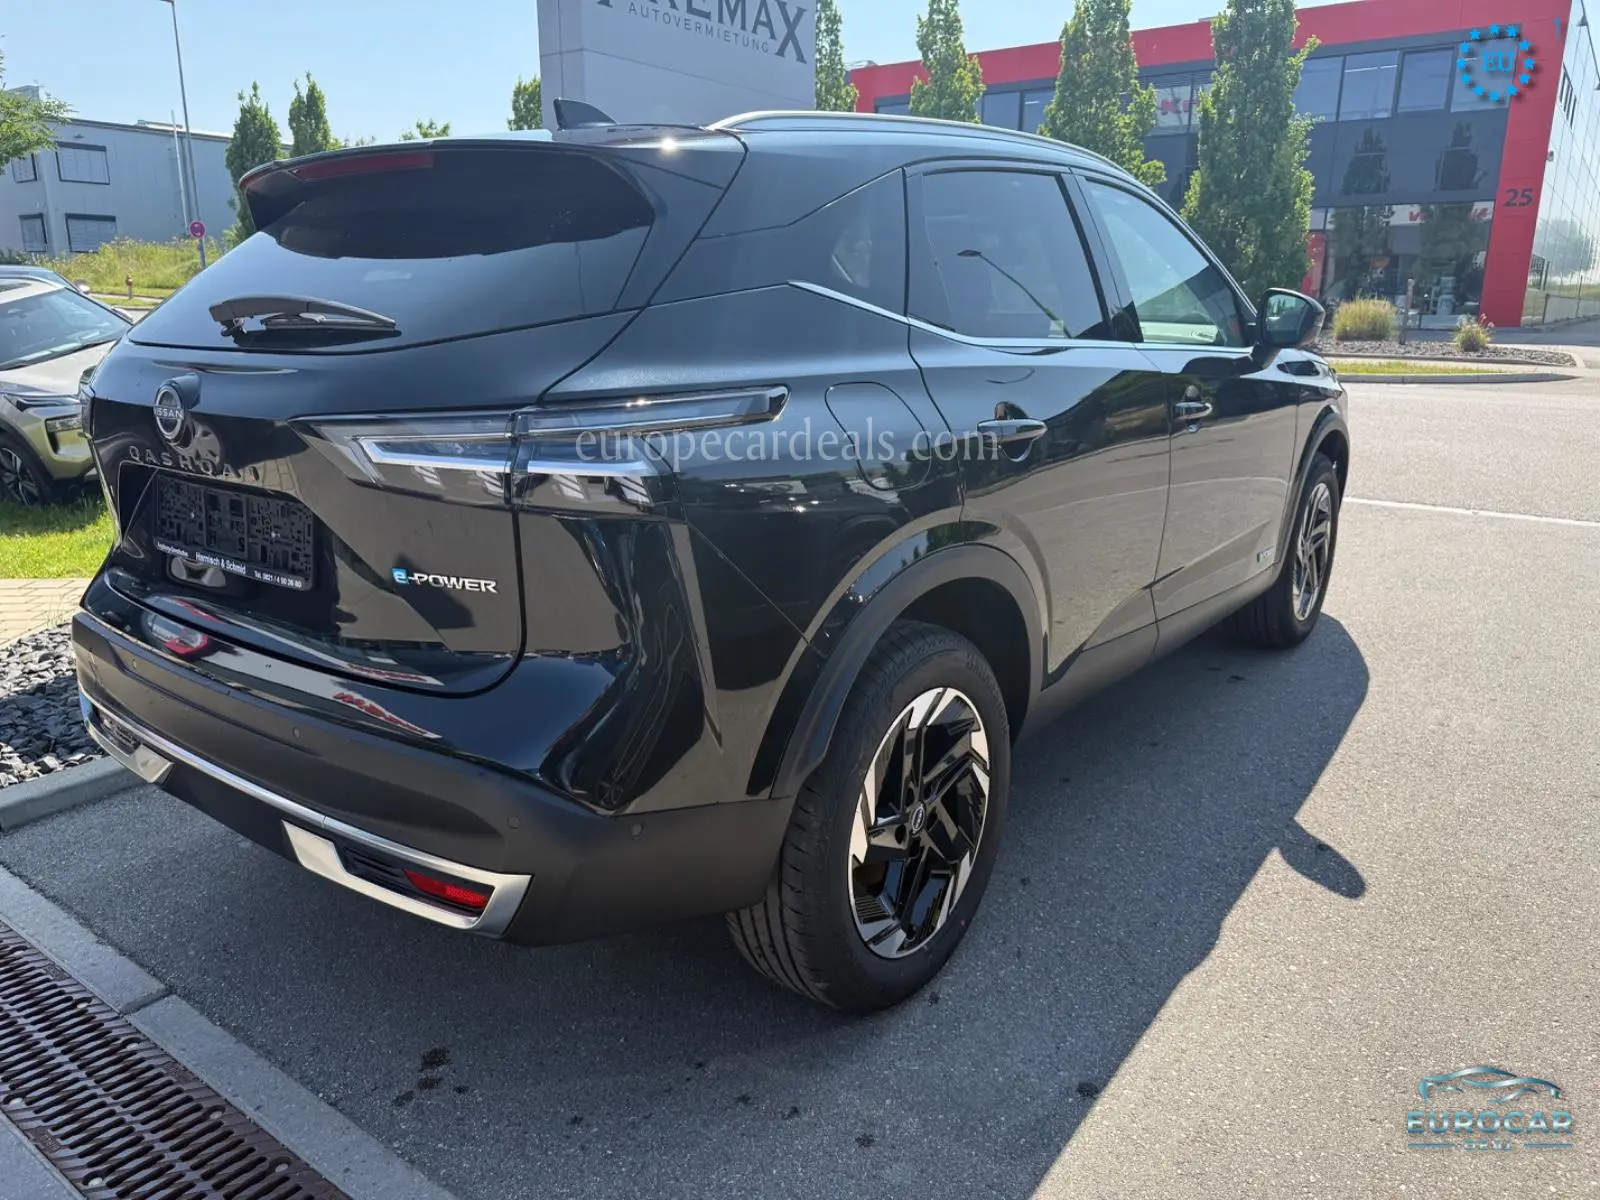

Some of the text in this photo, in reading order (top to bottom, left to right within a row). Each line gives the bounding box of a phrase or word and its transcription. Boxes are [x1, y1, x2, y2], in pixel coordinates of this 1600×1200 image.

[628, 3, 770, 54] AUTOVERMIETUNG
[1503, 188, 1534, 207] 25
[392, 568, 498, 593] e-POWER
